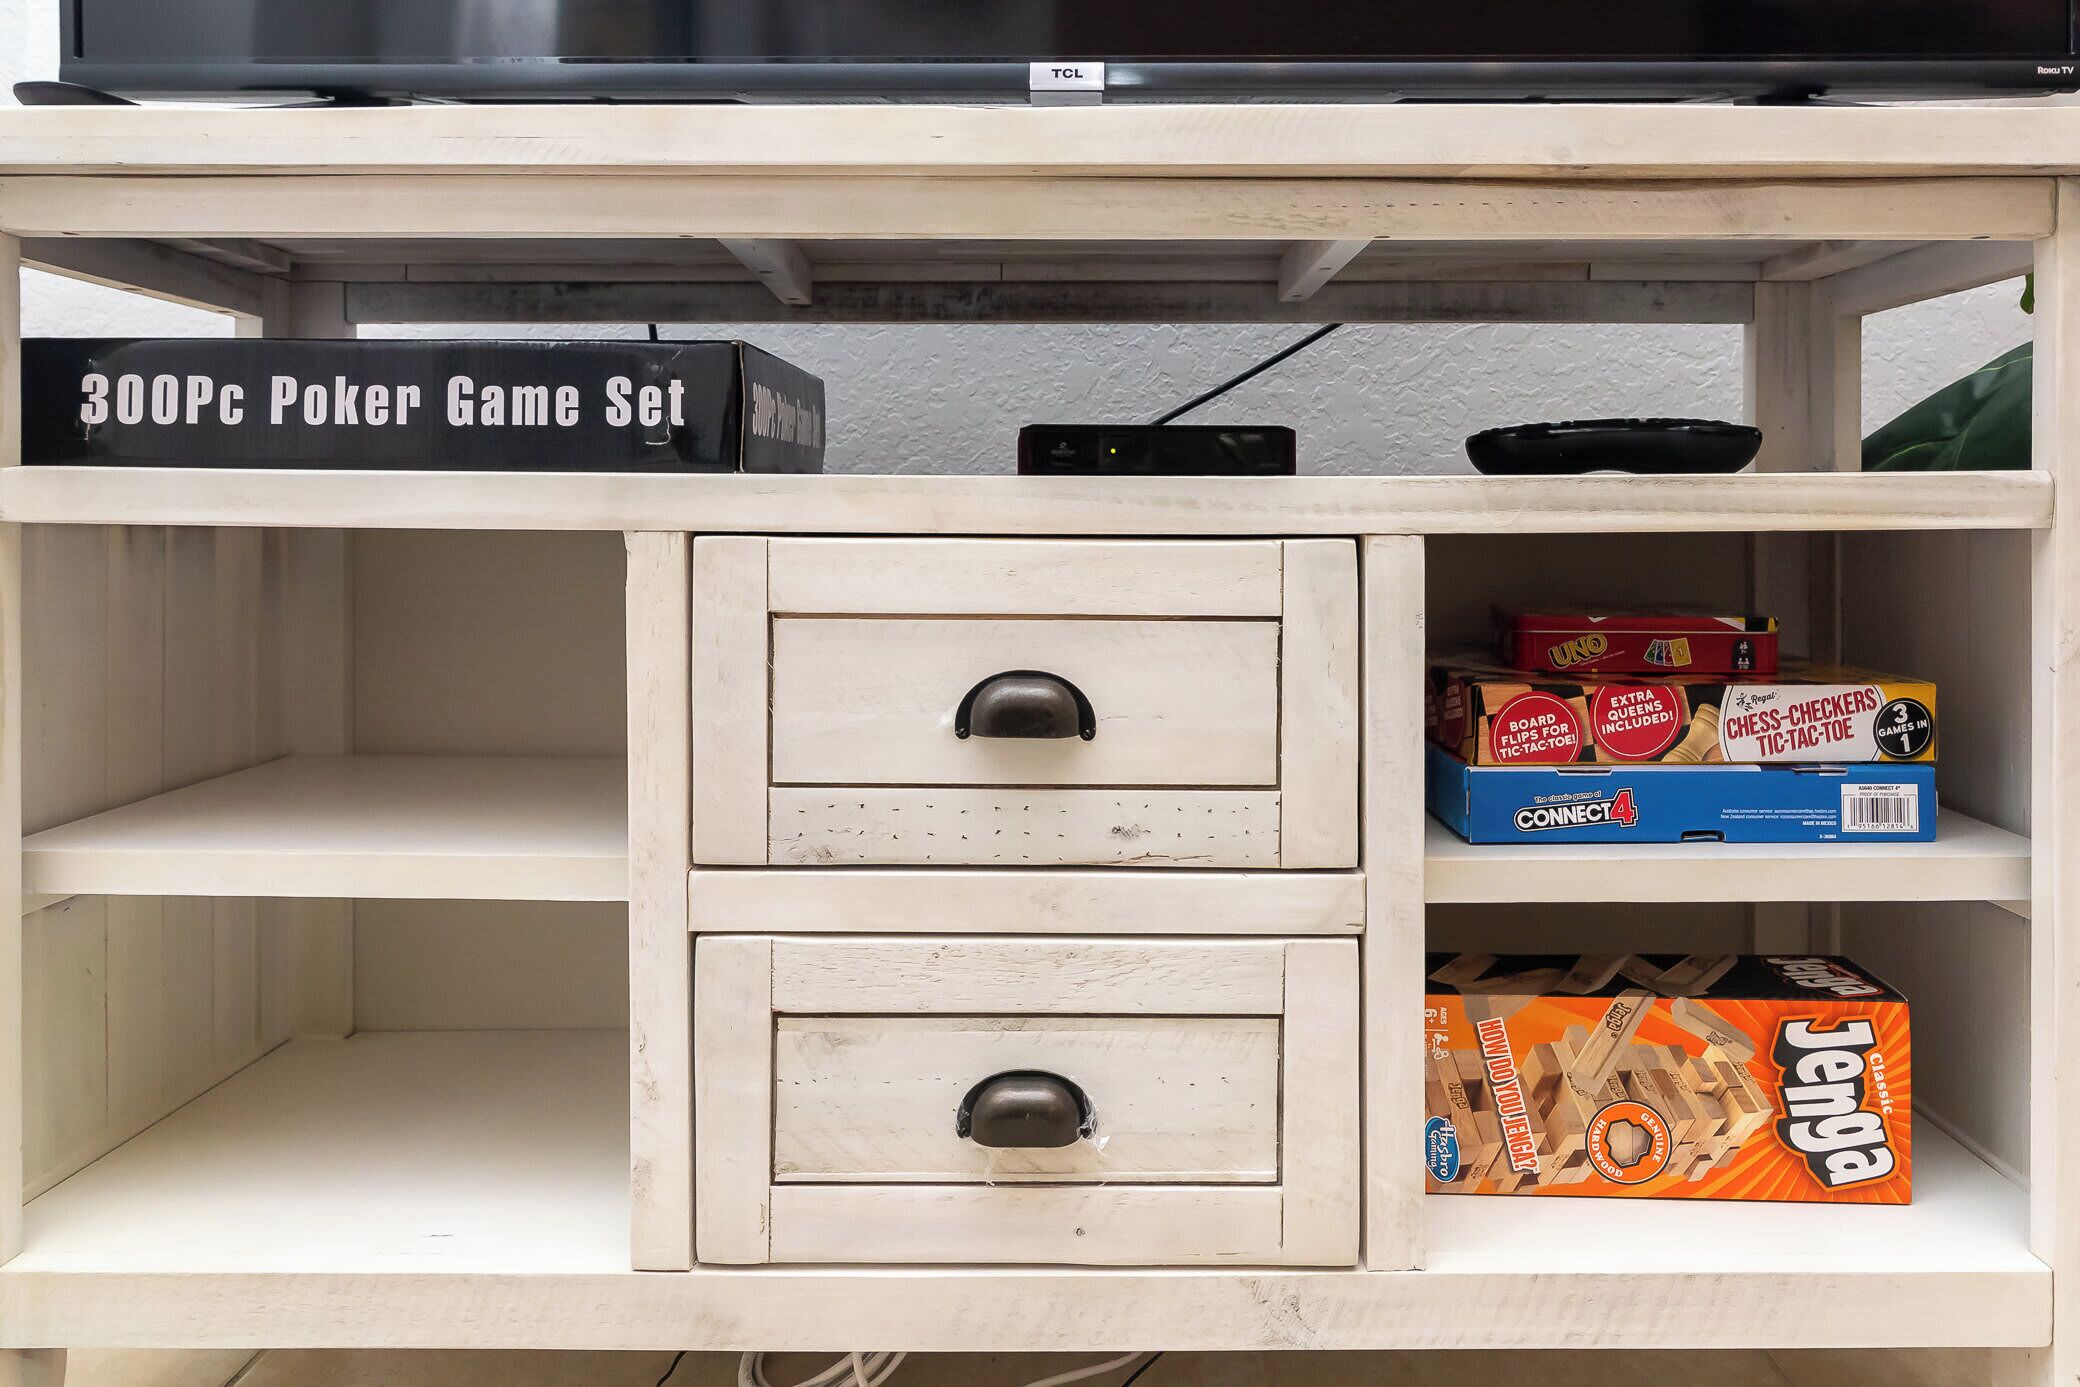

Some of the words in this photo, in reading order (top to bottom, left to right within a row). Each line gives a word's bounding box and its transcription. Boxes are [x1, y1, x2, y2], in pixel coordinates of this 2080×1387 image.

[1051, 69, 1083, 78] TCL
[2037, 66, 2060, 74] Roku
[2061, 66, 2074, 74] TV
[81, 374, 244, 425] 300Pc
[271, 376, 421, 425] Poker
[447, 376, 579, 427] Game
[605, 376, 685, 427] Set
[1548, 633, 1607, 668] UNO
[1607, 700, 1663, 721] QUEENS
[1610, 689, 1655, 708] EXTRA
[1750, 691, 1775, 706] Regal
[1509, 713, 1556, 732] BOARD
[1601, 710, 1674, 735] INCLUDED!
[1726, 687, 1878, 740] CHESS-CHECKERS
[1892, 703, 1909, 724] 3
[1501, 730, 1539, 746] FLIPS
[1542, 723, 1569, 738] FOR
[1755, 717, 1855, 757] TIC-TAC-TOE
[1878, 723, 1915, 737] GAMES
[1916, 719, 1928, 729] IN
[1499, 733, 1576, 759] TIC-TAC-TOE!
[1900, 733, 1911, 753] 1
[1517, 802, 1612, 829] CONNECT
[1610, 791, 1634, 824] 4
[1534, 795, 1547, 804] The
[1548, 793, 1572, 802] classic
[1572, 791, 1593, 801] game
[1593, 790, 1601, 798] of
[1766, 958, 1879, 996] Jenga
[1440, 1006, 1448, 1025] AGES
[1606, 1002, 1632, 1031] Jenga
[1479, 1019, 1509, 1056] HOW
[1488, 1057, 1516, 1082] DO
[1448, 1082, 1470, 1110] Jenga
[1869, 1053, 1894, 1115] Classic
[1495, 1082, 1524, 1116] YOU
[1785, 1021, 1894, 1186] Jenga
[1426, 1129, 1441, 1169] Gaming
[1439, 1120, 1455, 1177] Hasbro
[1503, 1116, 1538, 1169] JENGA?
[1591, 1118, 1624, 1177] HARDWOOD
[1640, 1112, 1664, 1163] GENUINE
